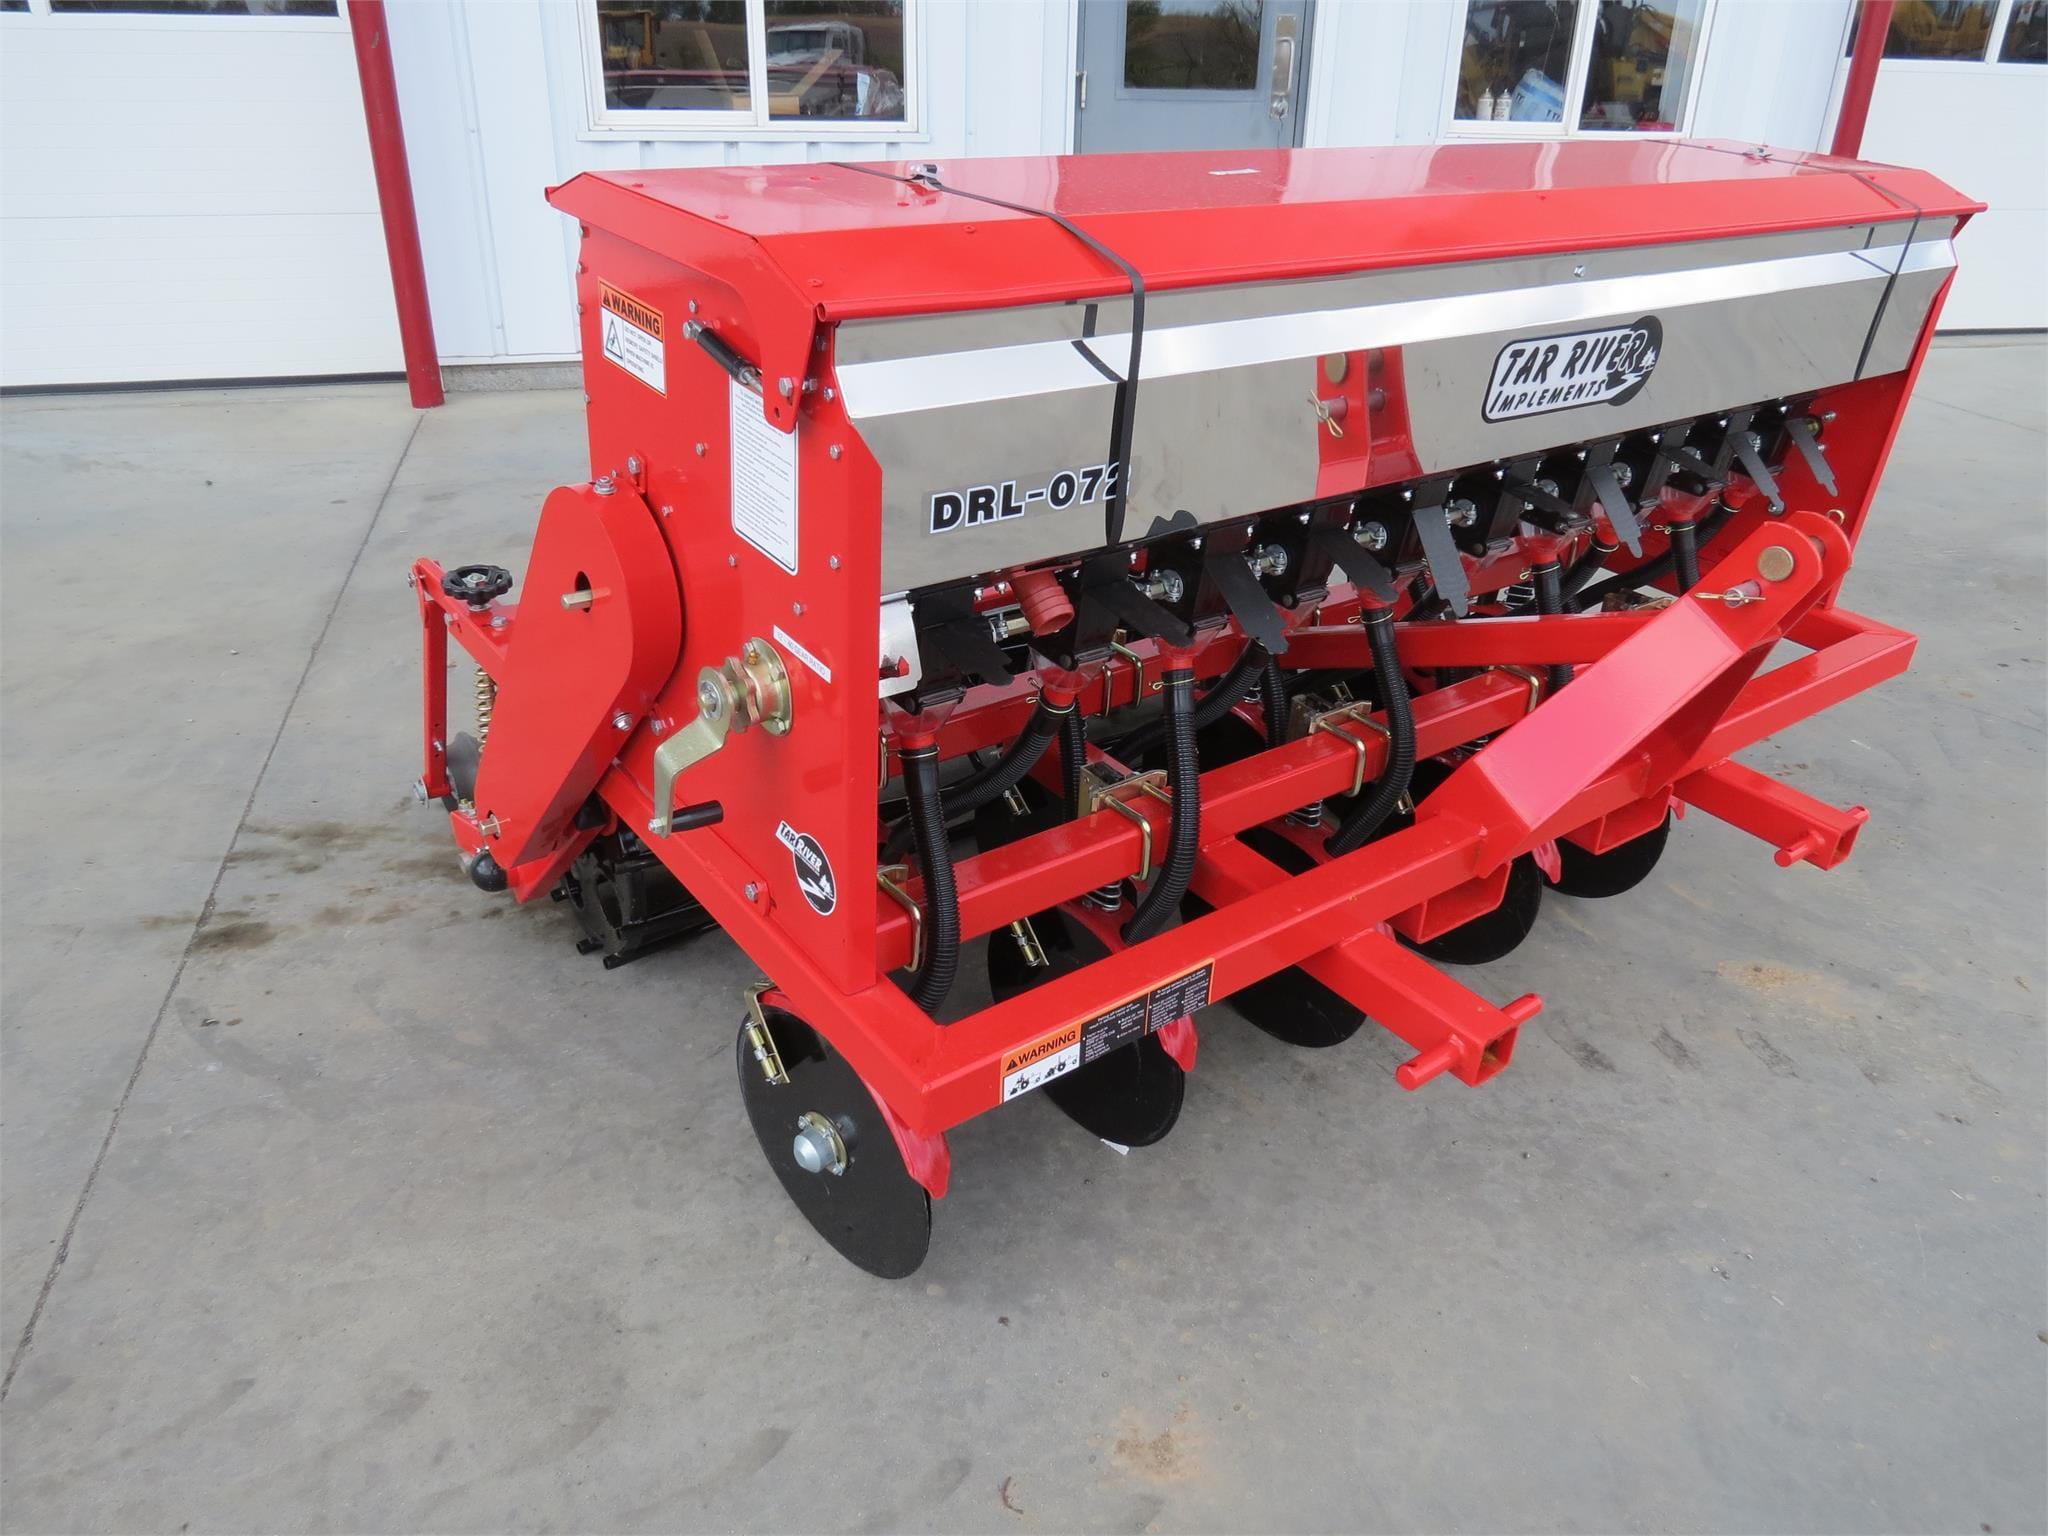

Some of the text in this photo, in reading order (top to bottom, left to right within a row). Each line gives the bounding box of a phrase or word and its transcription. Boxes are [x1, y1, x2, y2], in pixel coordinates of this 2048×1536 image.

[611, 294, 660, 335] WARNING
[1499, 329, 1649, 387] TAR RIVER
[1488, 378, 1608, 414] IMPLEMENTS
[930, 462, 1132, 533] DRL-072
[780, 822, 796, 846] TAR
[796, 838, 822, 872] RIVER
[1018, 1030, 1076, 1065] WARNING
